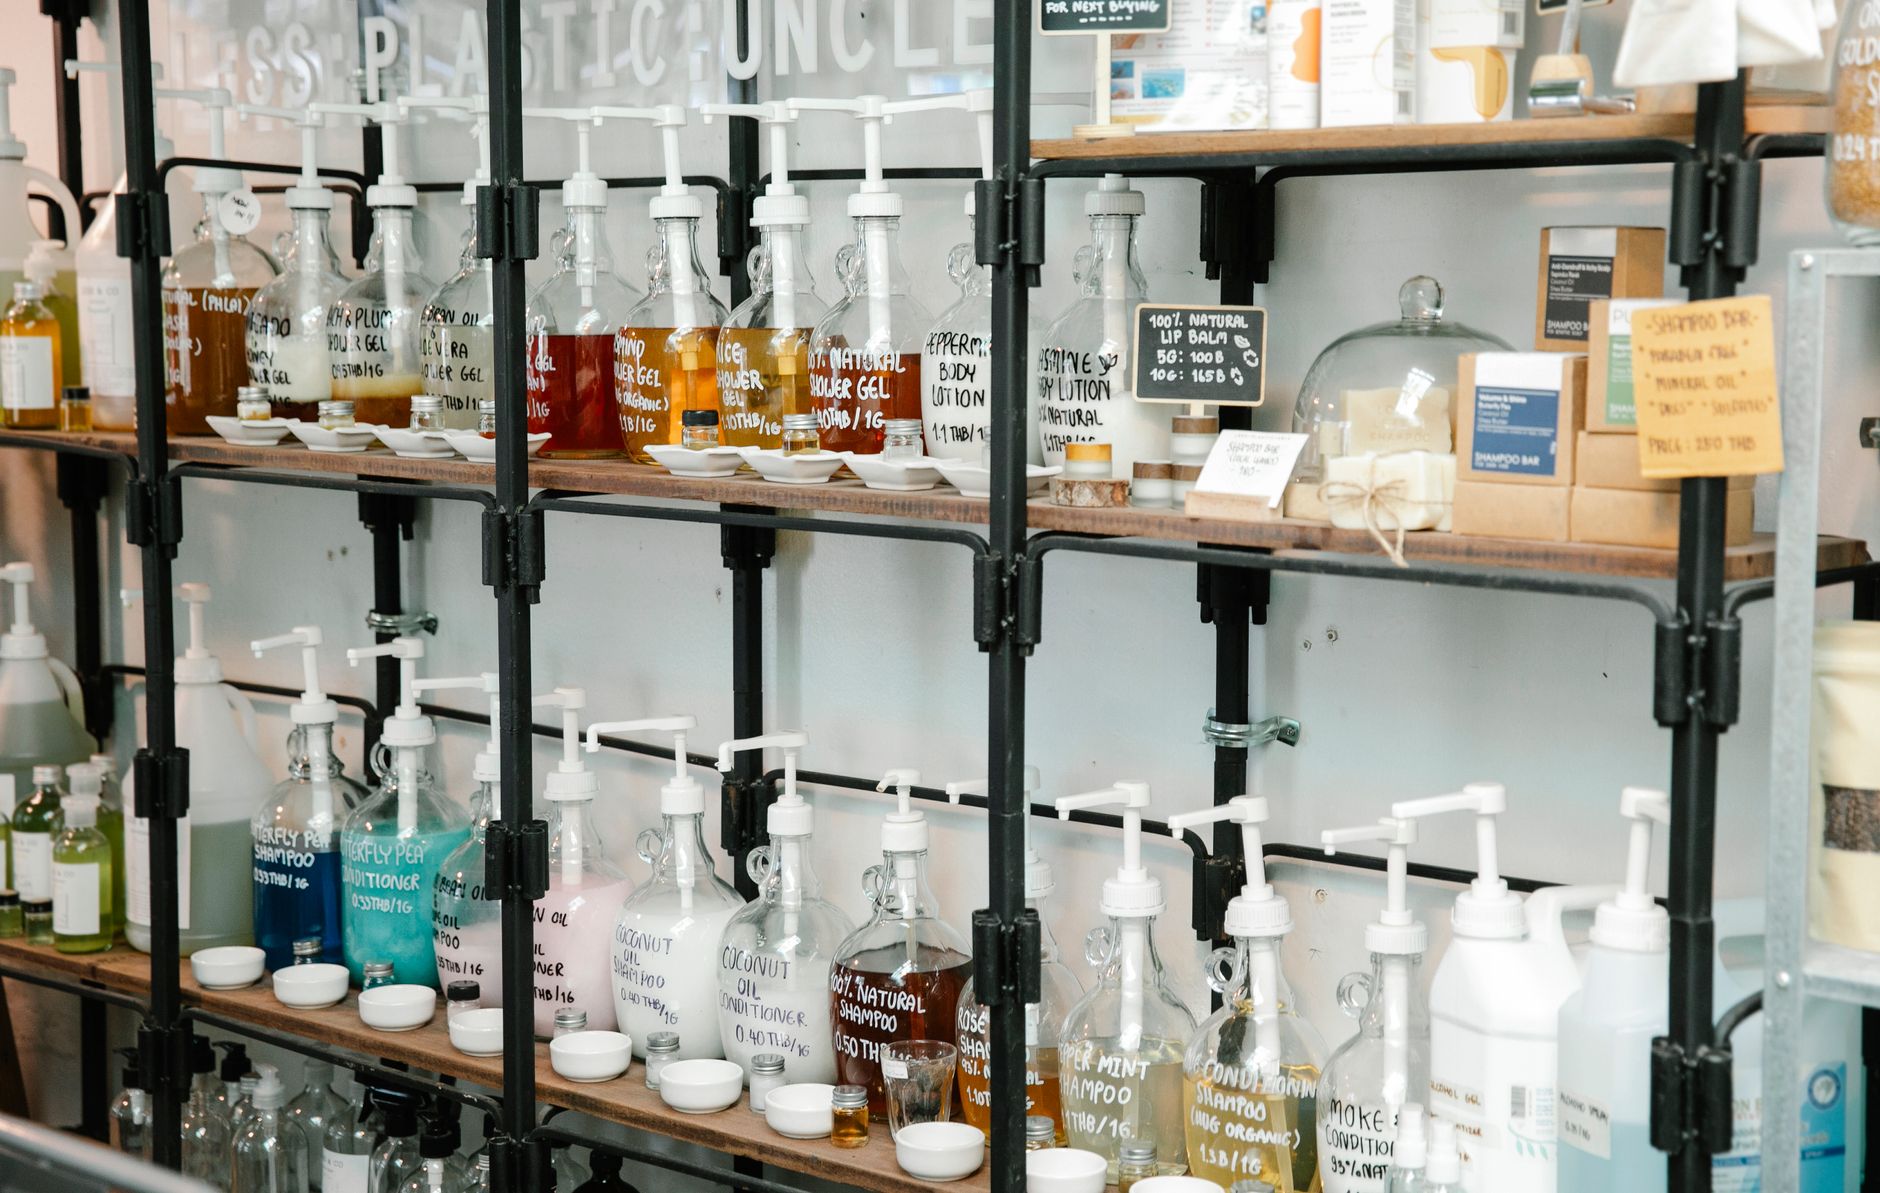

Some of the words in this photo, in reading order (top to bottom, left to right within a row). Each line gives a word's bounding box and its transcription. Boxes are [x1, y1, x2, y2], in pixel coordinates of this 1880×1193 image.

[1045, 1, 1069, 14] FOR
[1072, 0, 1105, 14] NEXT
[1109, 0, 1161, 14] BUYING
[1149, 312, 1183, 328] 100%
[1189, 313, 1248, 328] NATURAL
[1547, 320, 1582, 331] SHAMPOO
[365, 334, 388, 352] GEL
[1161, 329, 1182, 344] LIP
[1188, 329, 1227, 344] BALM
[830, 347, 906, 374] NATURAL
[1039, 348, 1091, 374] ASMINE
[1157, 349, 1183, 364] 5G:
[272, 368, 291, 385] GEL
[460, 365, 485, 383] GEL
[637, 365, 661, 387] GEL
[940, 362, 976, 383] BODY
[1150, 368, 1184, 381] 10G:
[857, 375, 891, 400] GEL
[932, 384, 985, 408] LOTION
[1475, 451, 1520, 465] SHAMPOO
[1522, 455, 1540, 466] BAR
[254, 844, 315, 867] SHAMPOO
[395, 843, 424, 866] PEA
[471, 886, 485, 900] OI
[443, 914, 461, 930] OIL
[551, 911, 568, 927] OIL
[534, 943, 546, 956] IL
[615, 923, 673, 955] COCONUT
[623, 949, 640, 966] OIL
[722, 946, 790, 979] COCONUT
[613, 955, 665, 988] SHAMPOO
[738, 977, 761, 1000] OIL
[857, 984, 926, 1014] NATURAL
[719, 989, 807, 1027] CONDITIONER
[840, 999, 897, 1032] SHAMPOO
[1097, 1055, 1151, 1081] MINT
[1060, 1073, 1132, 1105] HAMPOO
[1197, 1081, 1267, 1121] SHAMPOO
[1325, 1124, 1394, 1157] CONDITIO
